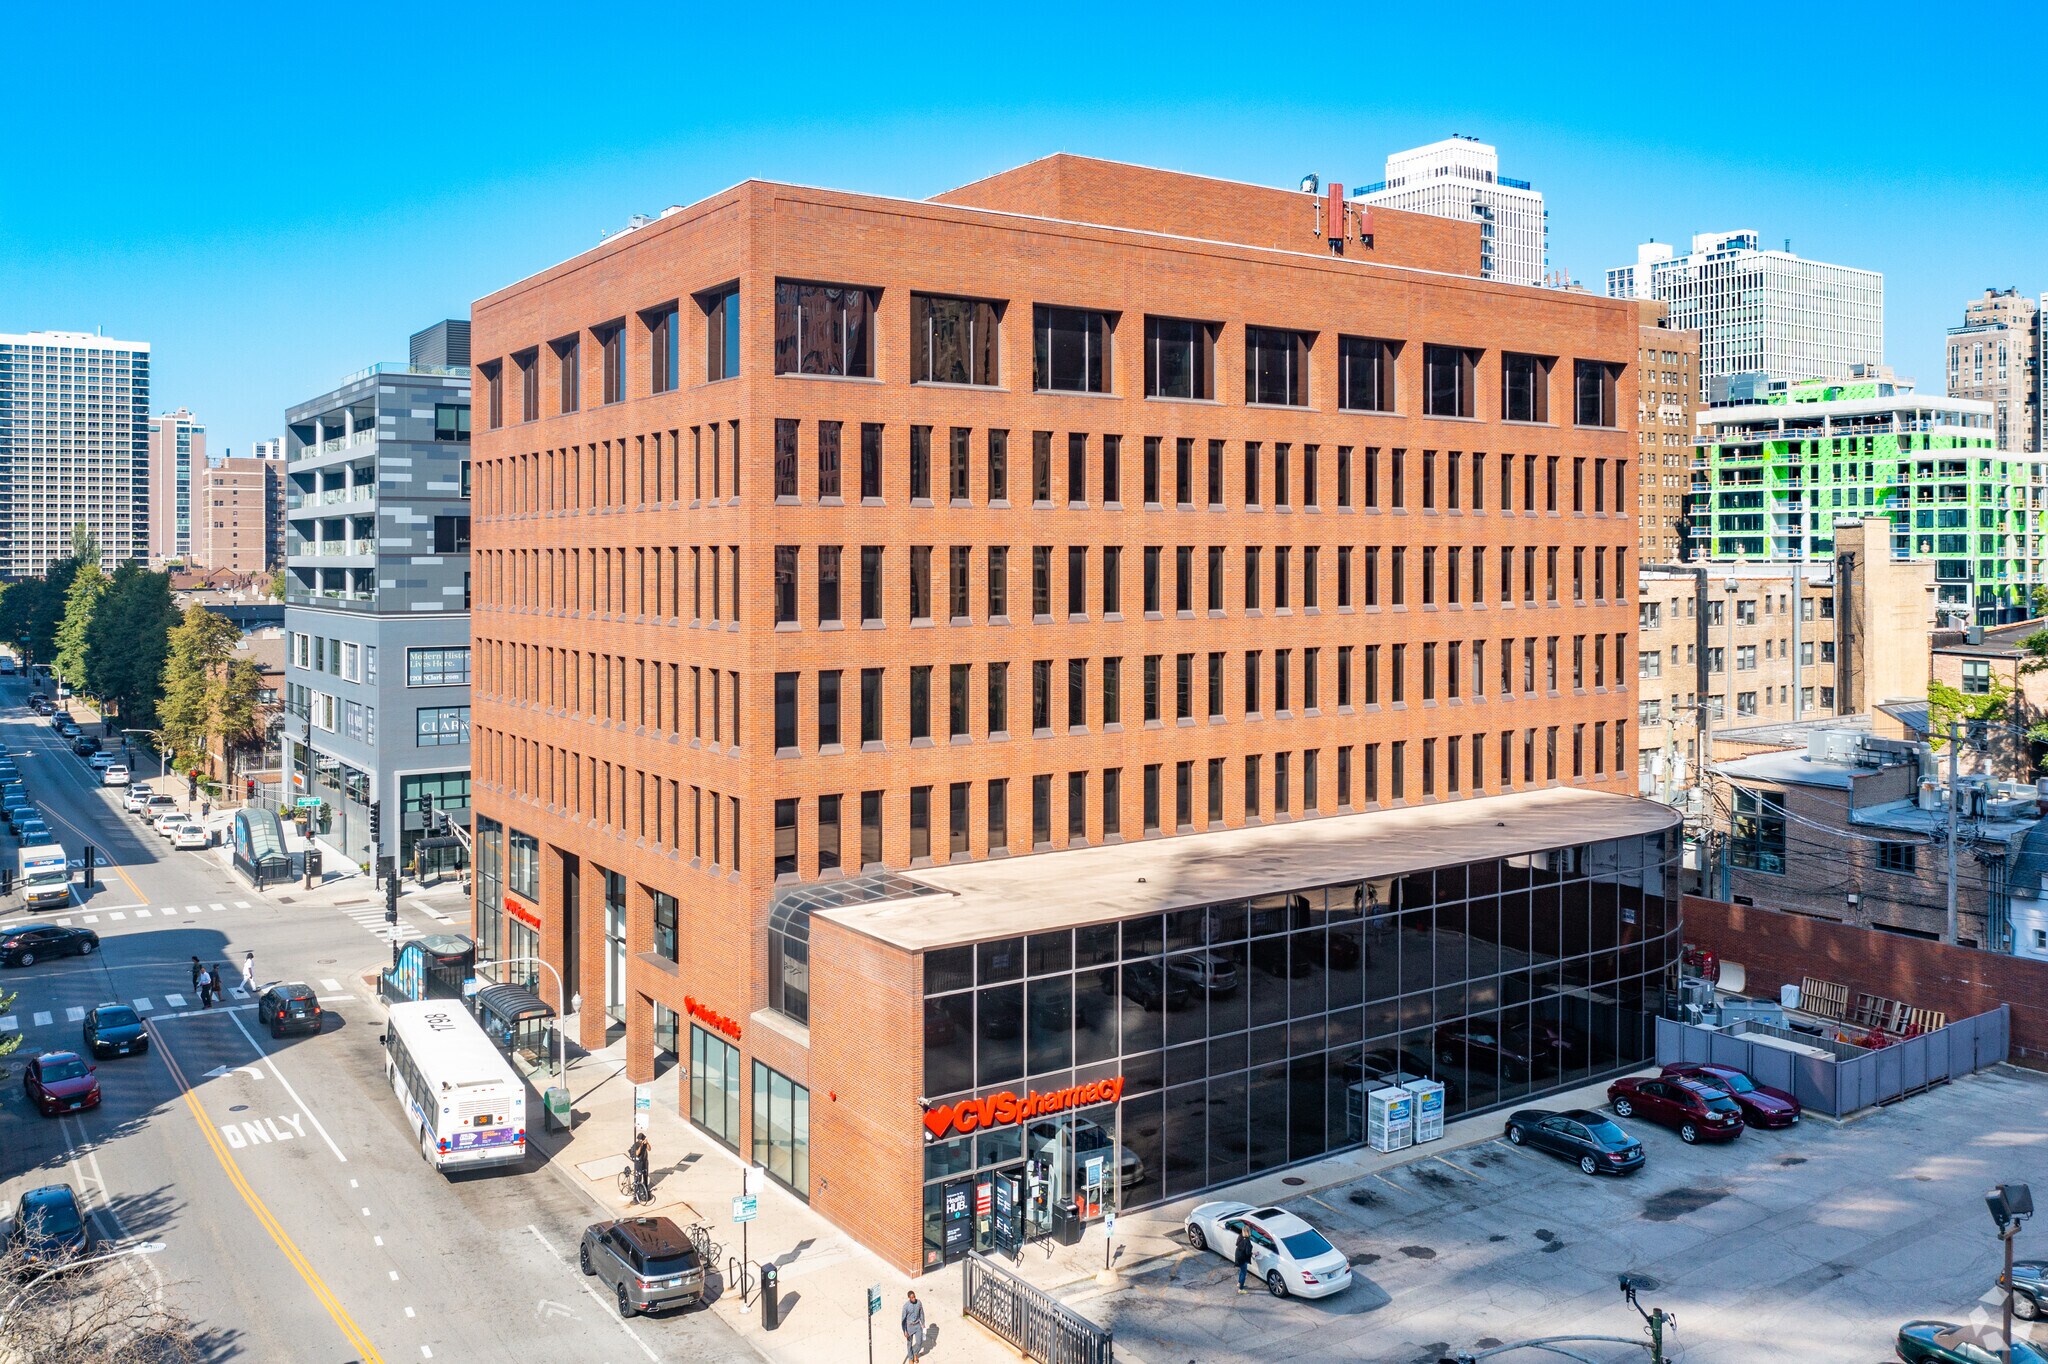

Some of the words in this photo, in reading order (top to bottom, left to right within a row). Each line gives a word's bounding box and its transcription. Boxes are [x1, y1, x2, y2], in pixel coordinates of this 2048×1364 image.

[410, 652, 442, 660] Modern
[421, 720, 470, 732] CLARK
[424, 1013, 456, 1032] 1798
[220, 1113, 306, 1149] ONLY
[946, 1195, 966, 1205] Health
